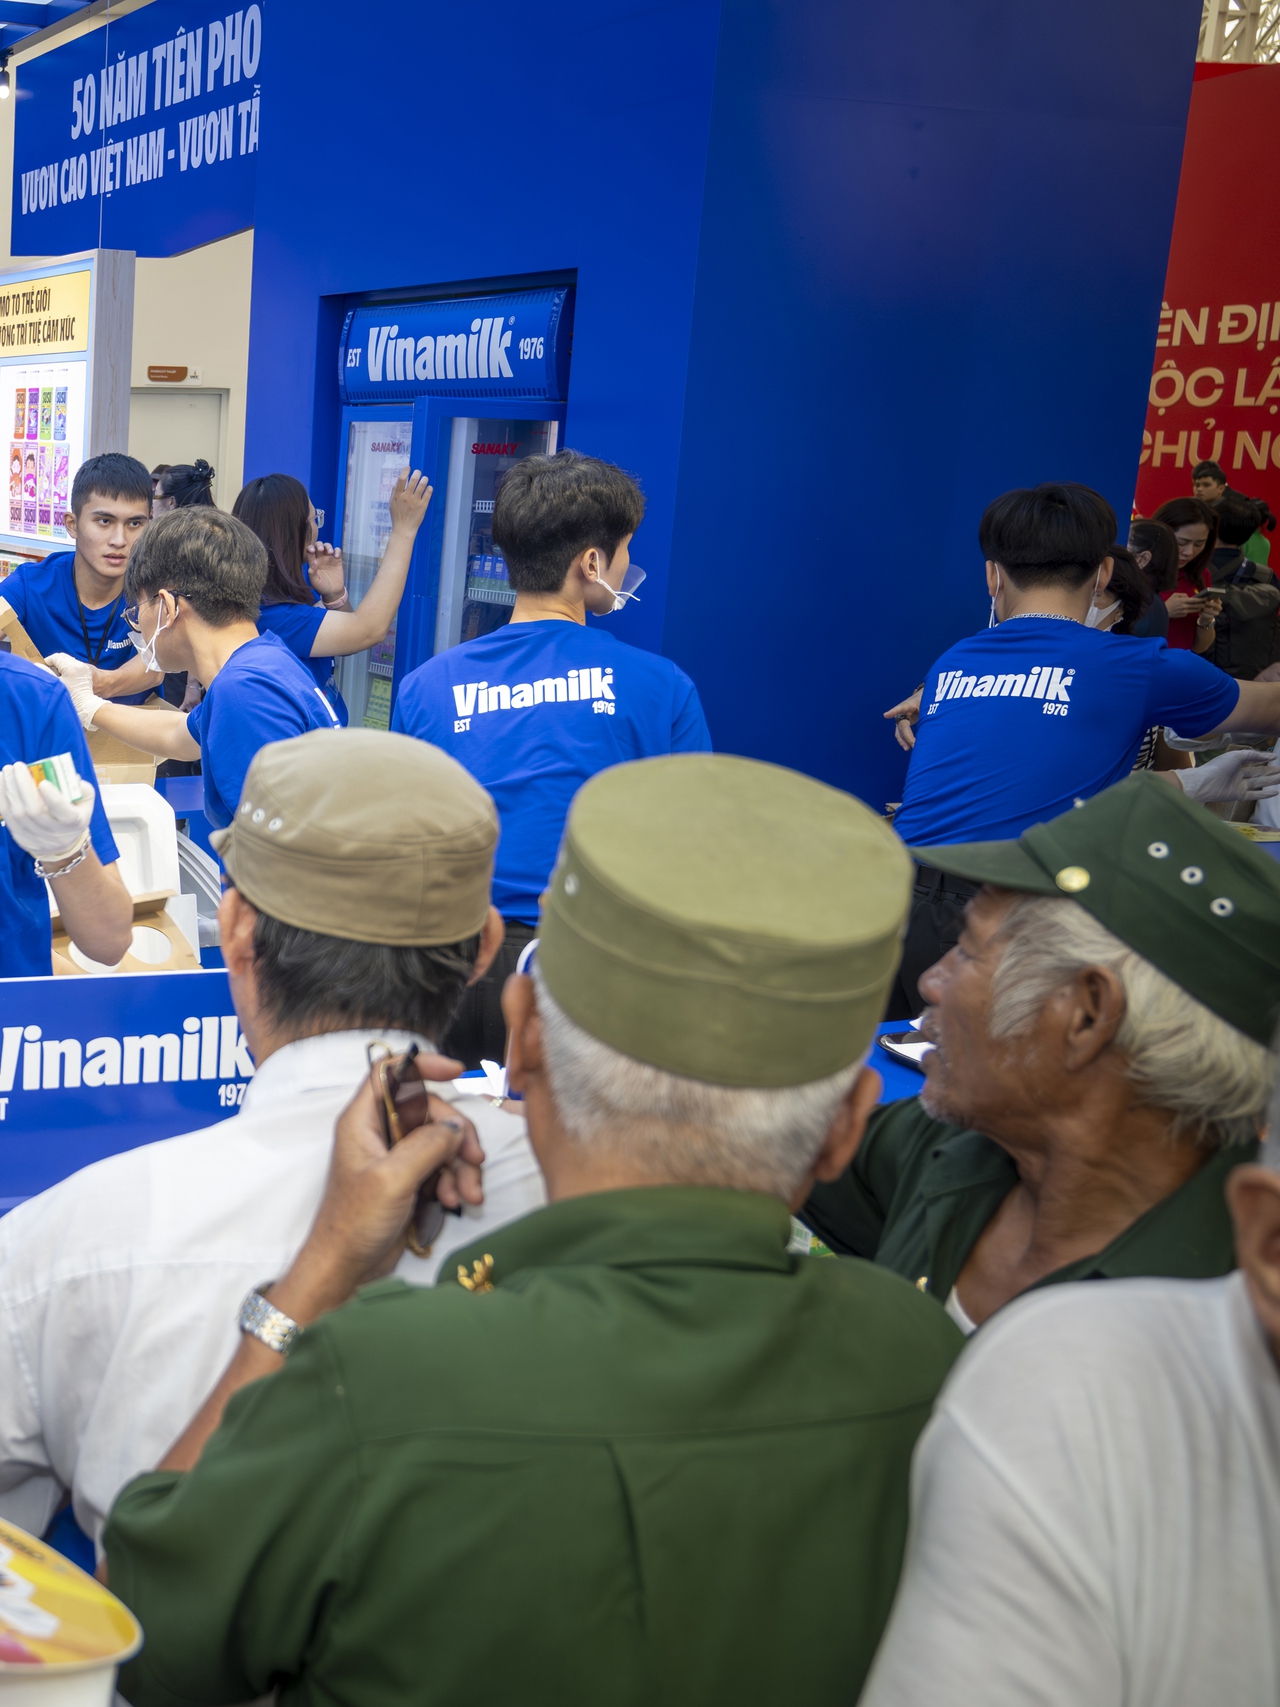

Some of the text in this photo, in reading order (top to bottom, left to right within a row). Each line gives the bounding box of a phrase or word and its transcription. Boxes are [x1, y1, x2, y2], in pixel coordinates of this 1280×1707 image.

[72, 3, 262, 140] 50 NĂM TIÊN PHO
[21, 162, 59, 216] VƯƠN
[60, 153, 88, 204] CAO
[90, 138, 124, 198] VIỆT
[125, 127, 165, 187] NAM
[179, 104, 235, 172] VƯƠN
[12, 294, 20, 316] TO
[22, 286, 35, 314] THẾ
[59, 314, 76, 342] XÚC
[346, 316, 544, 382] EST Vinamilk 1976
[371, 442, 402, 452] SANAKY
[471, 442, 518, 455] SANAKY
[452, 667, 616, 717] Vinamilk
[934, 666, 1074, 702] Vinamilk
[454, 700, 616, 733] EST 1976
[1042, 702, 1068, 717] 1976
